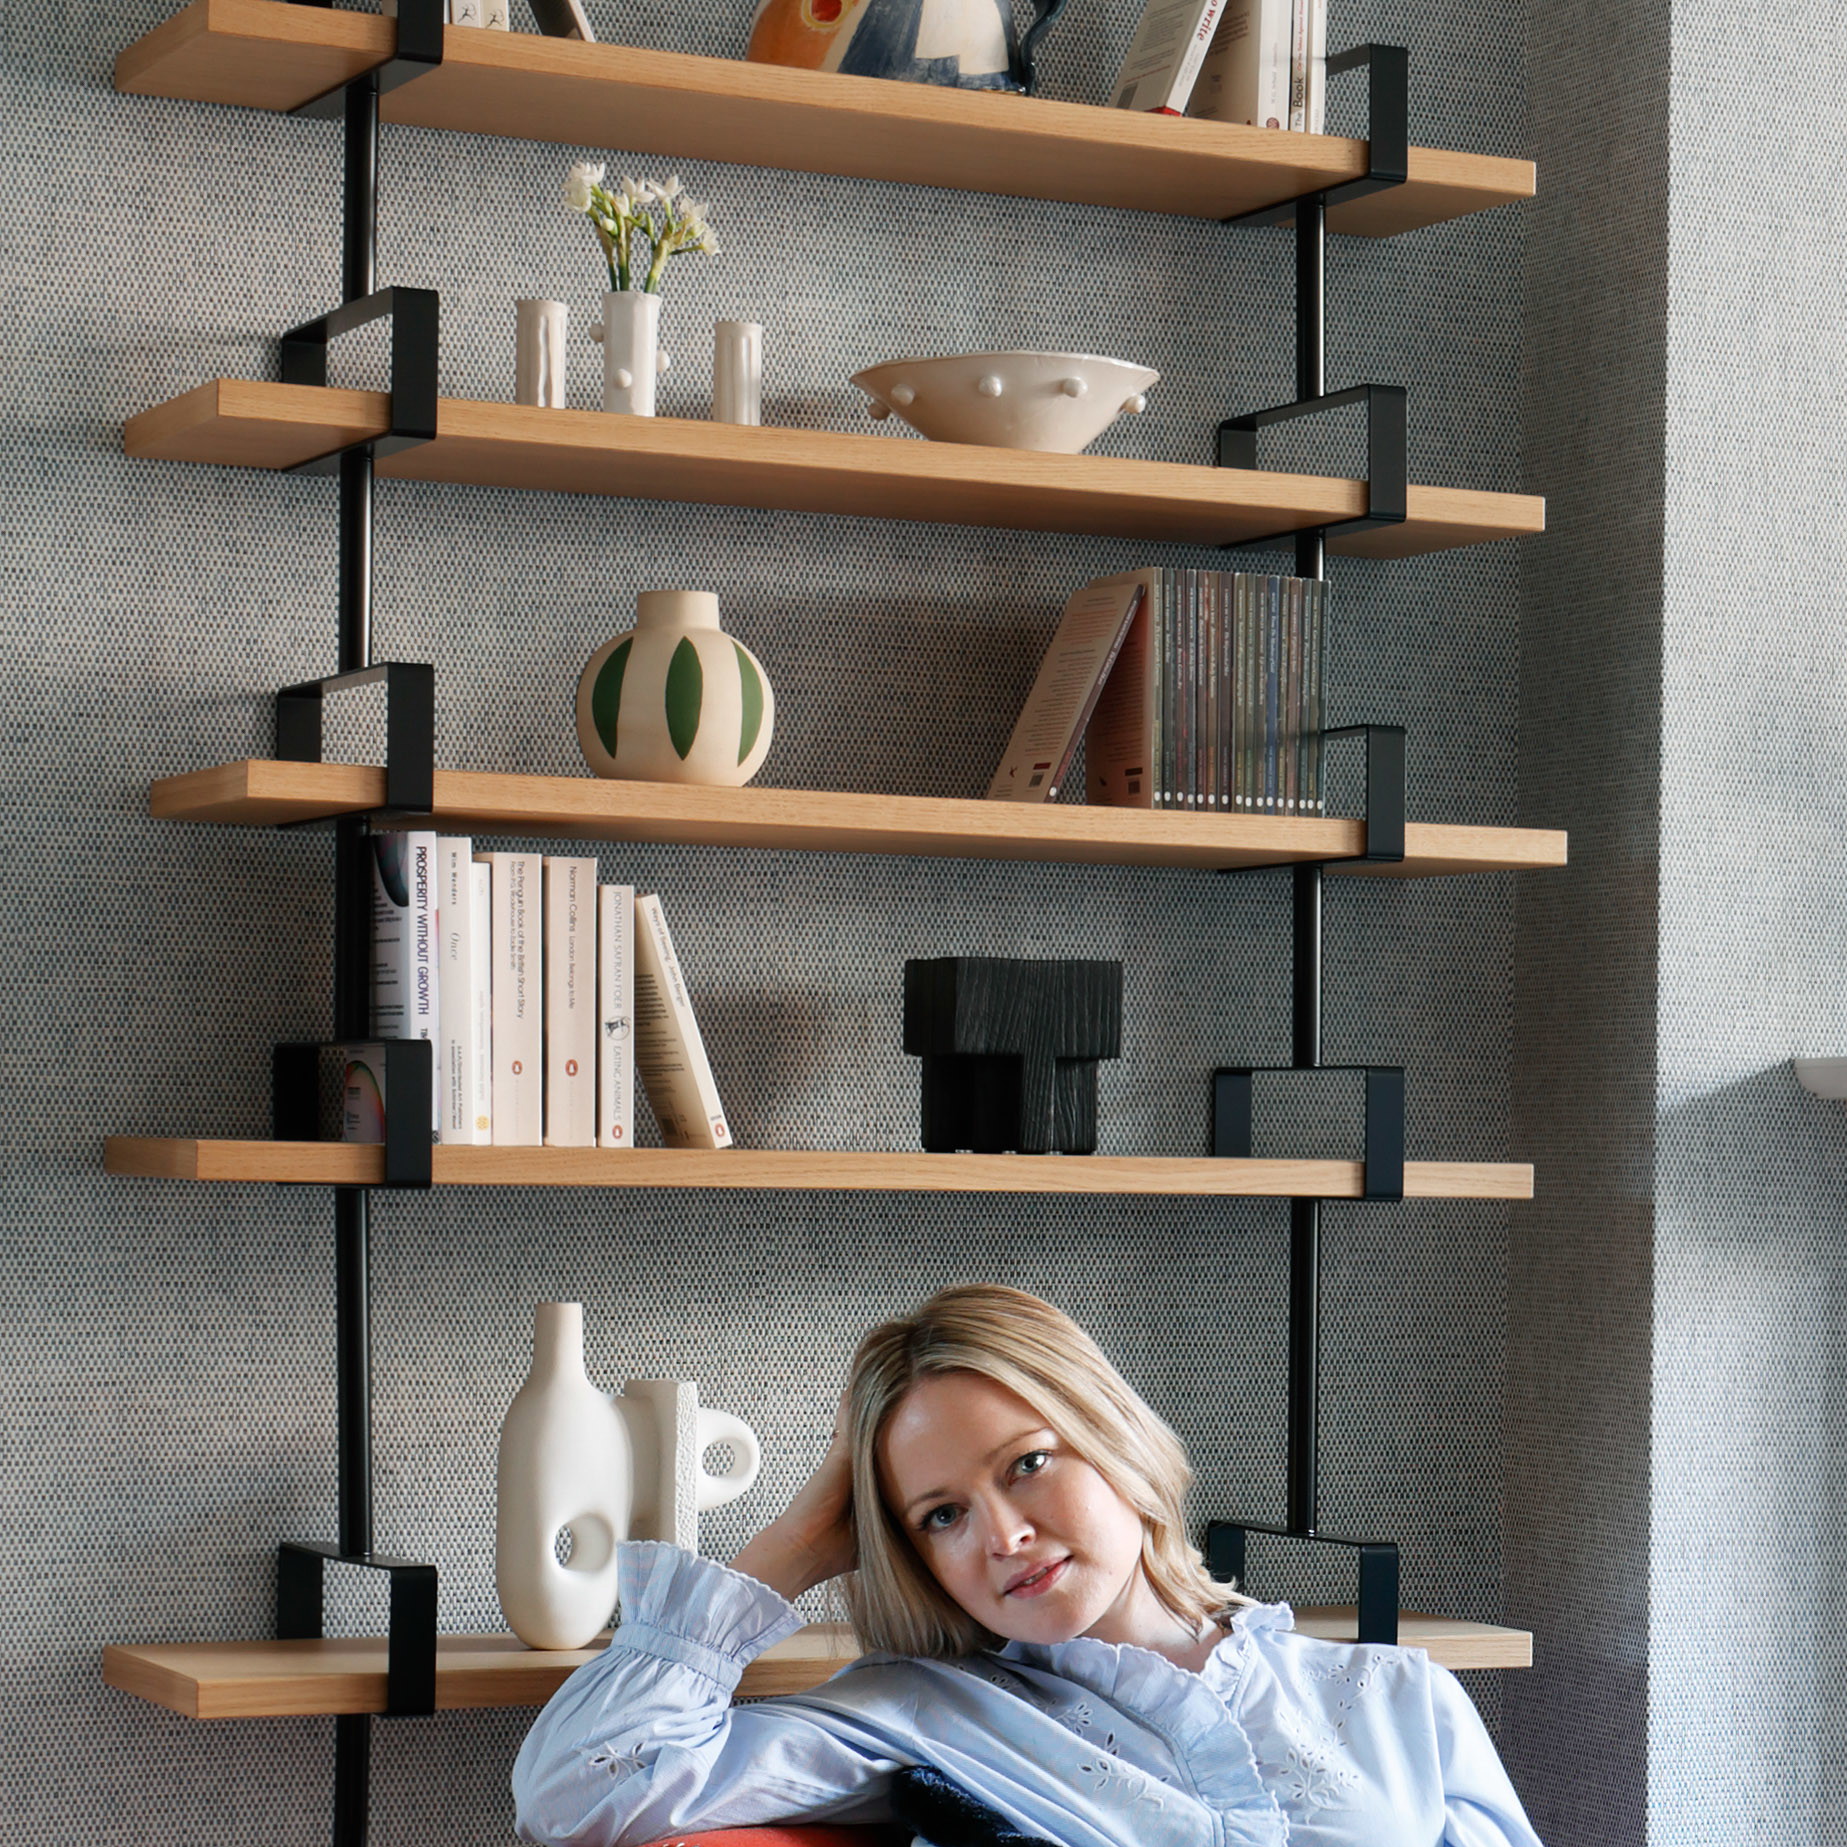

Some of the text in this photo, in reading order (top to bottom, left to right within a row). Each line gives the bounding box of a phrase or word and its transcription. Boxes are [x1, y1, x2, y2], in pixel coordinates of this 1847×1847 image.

[1197, 9, 1216, 41] write
[1293, 76, 1305, 108] Book
[1294, 113, 1303, 128] The
[416, 846, 429, 911] PROSPERITY
[568, 865, 577, 902] Norman
[568, 903, 577, 932] Collins
[416, 913, 429, 963] WITHOUT
[450, 932, 461, 961] Once
[515, 861, 525, 1019] The Penguin Book of the British Short Story
[568, 935, 576, 962] London
[567, 962, 576, 989] Belongs
[669, 965, 678, 982] John
[417, 966, 429, 1015] GROWTH
[568, 997, 575, 1009] Me
[613, 891, 623, 1121] JONATHAN SAFRAN FOER EATING ANIMALS
